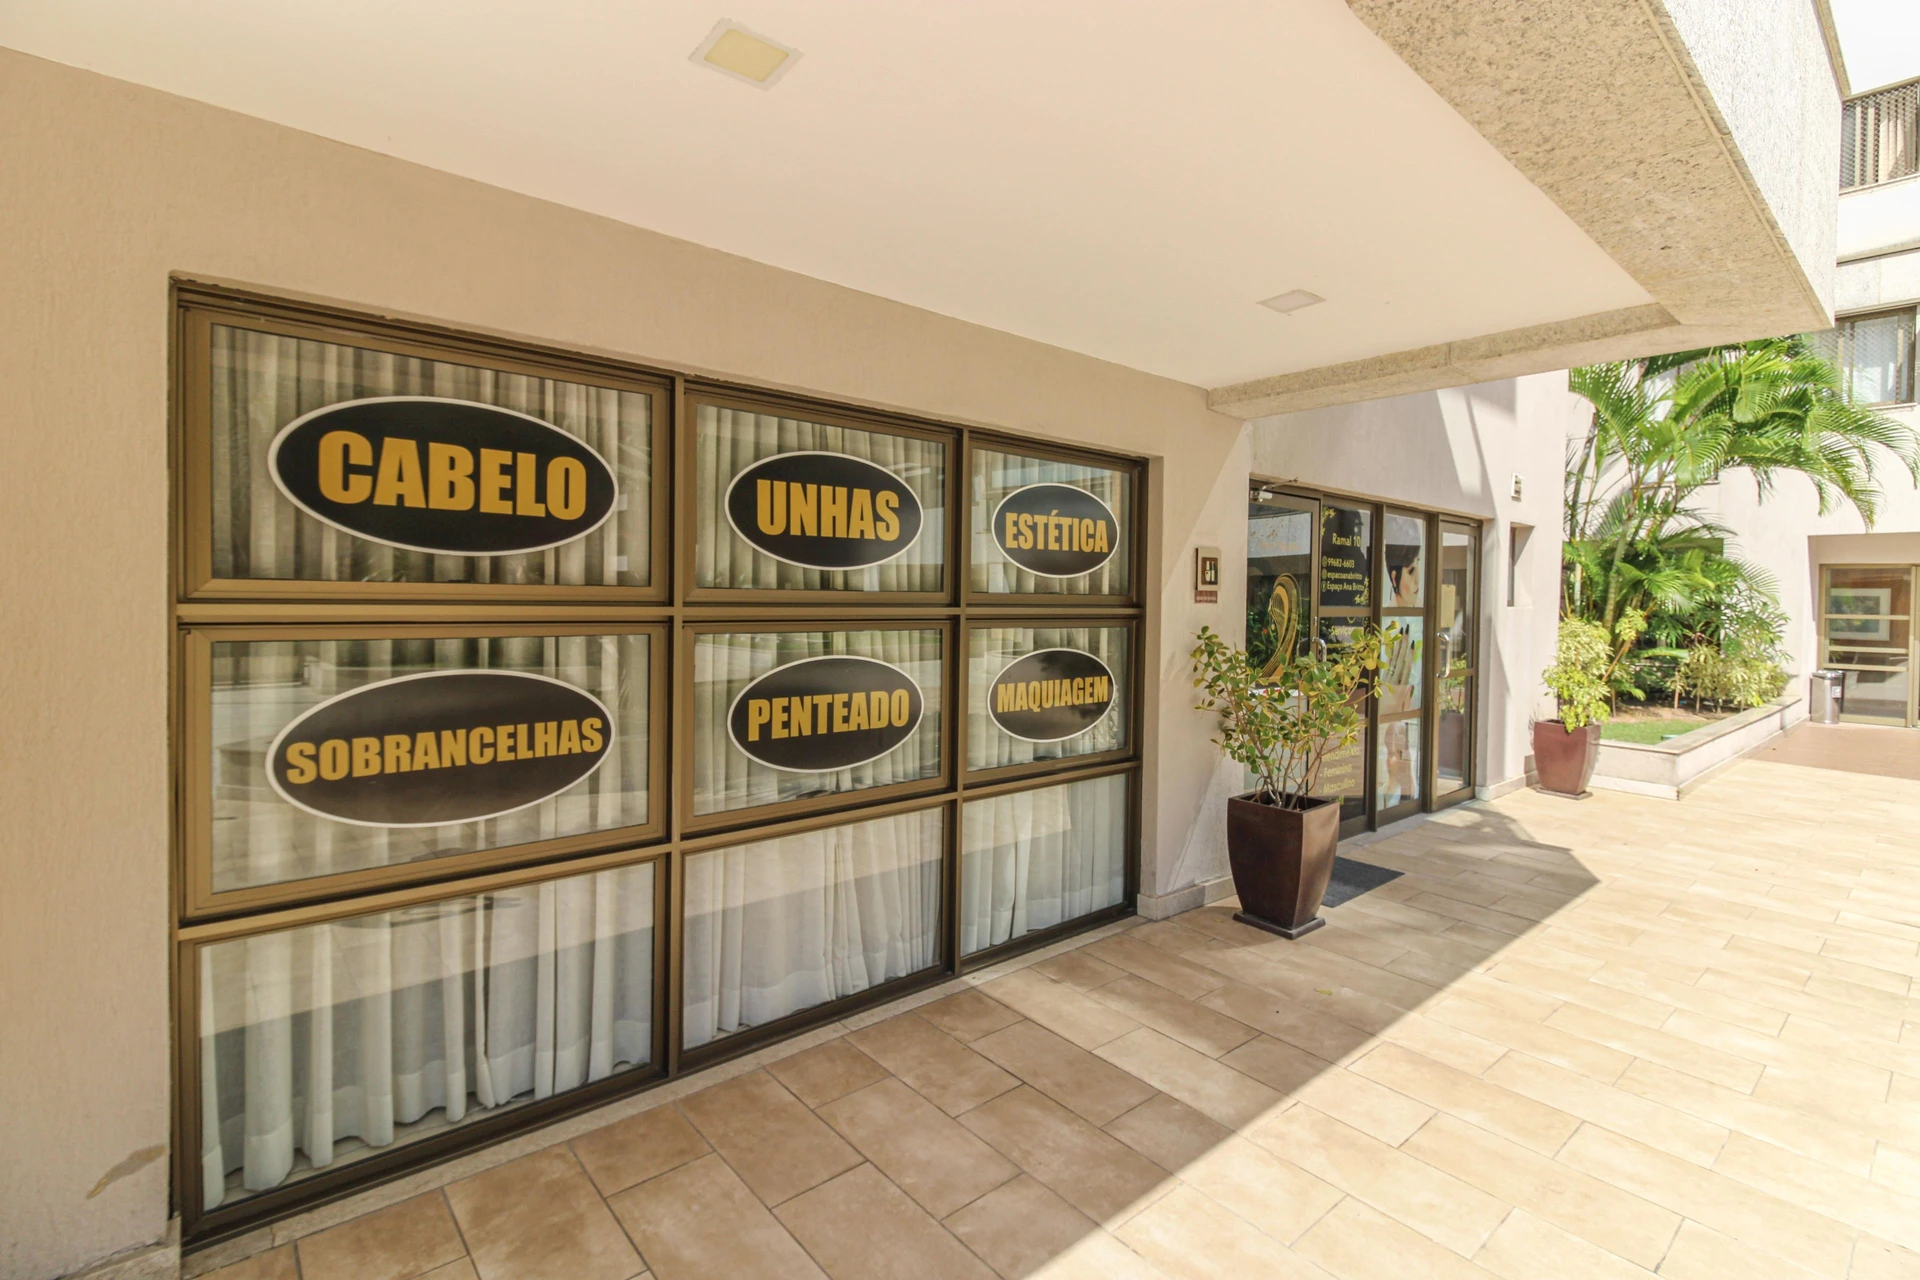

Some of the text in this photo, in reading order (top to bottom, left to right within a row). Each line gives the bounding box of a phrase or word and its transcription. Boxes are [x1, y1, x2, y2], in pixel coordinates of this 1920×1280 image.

[317, 429, 588, 522] CABELO
[755, 477, 902, 543] UNHAS
[1004, 511, 1110, 555] ESTÉTICA
[1332, 532, 1352, 547] Ramal
[746, 687, 912, 743] PENTEADO
[995, 674, 1110, 715] MAQUIAGEM
[284, 715, 604, 786] SOBRANCELHAS
